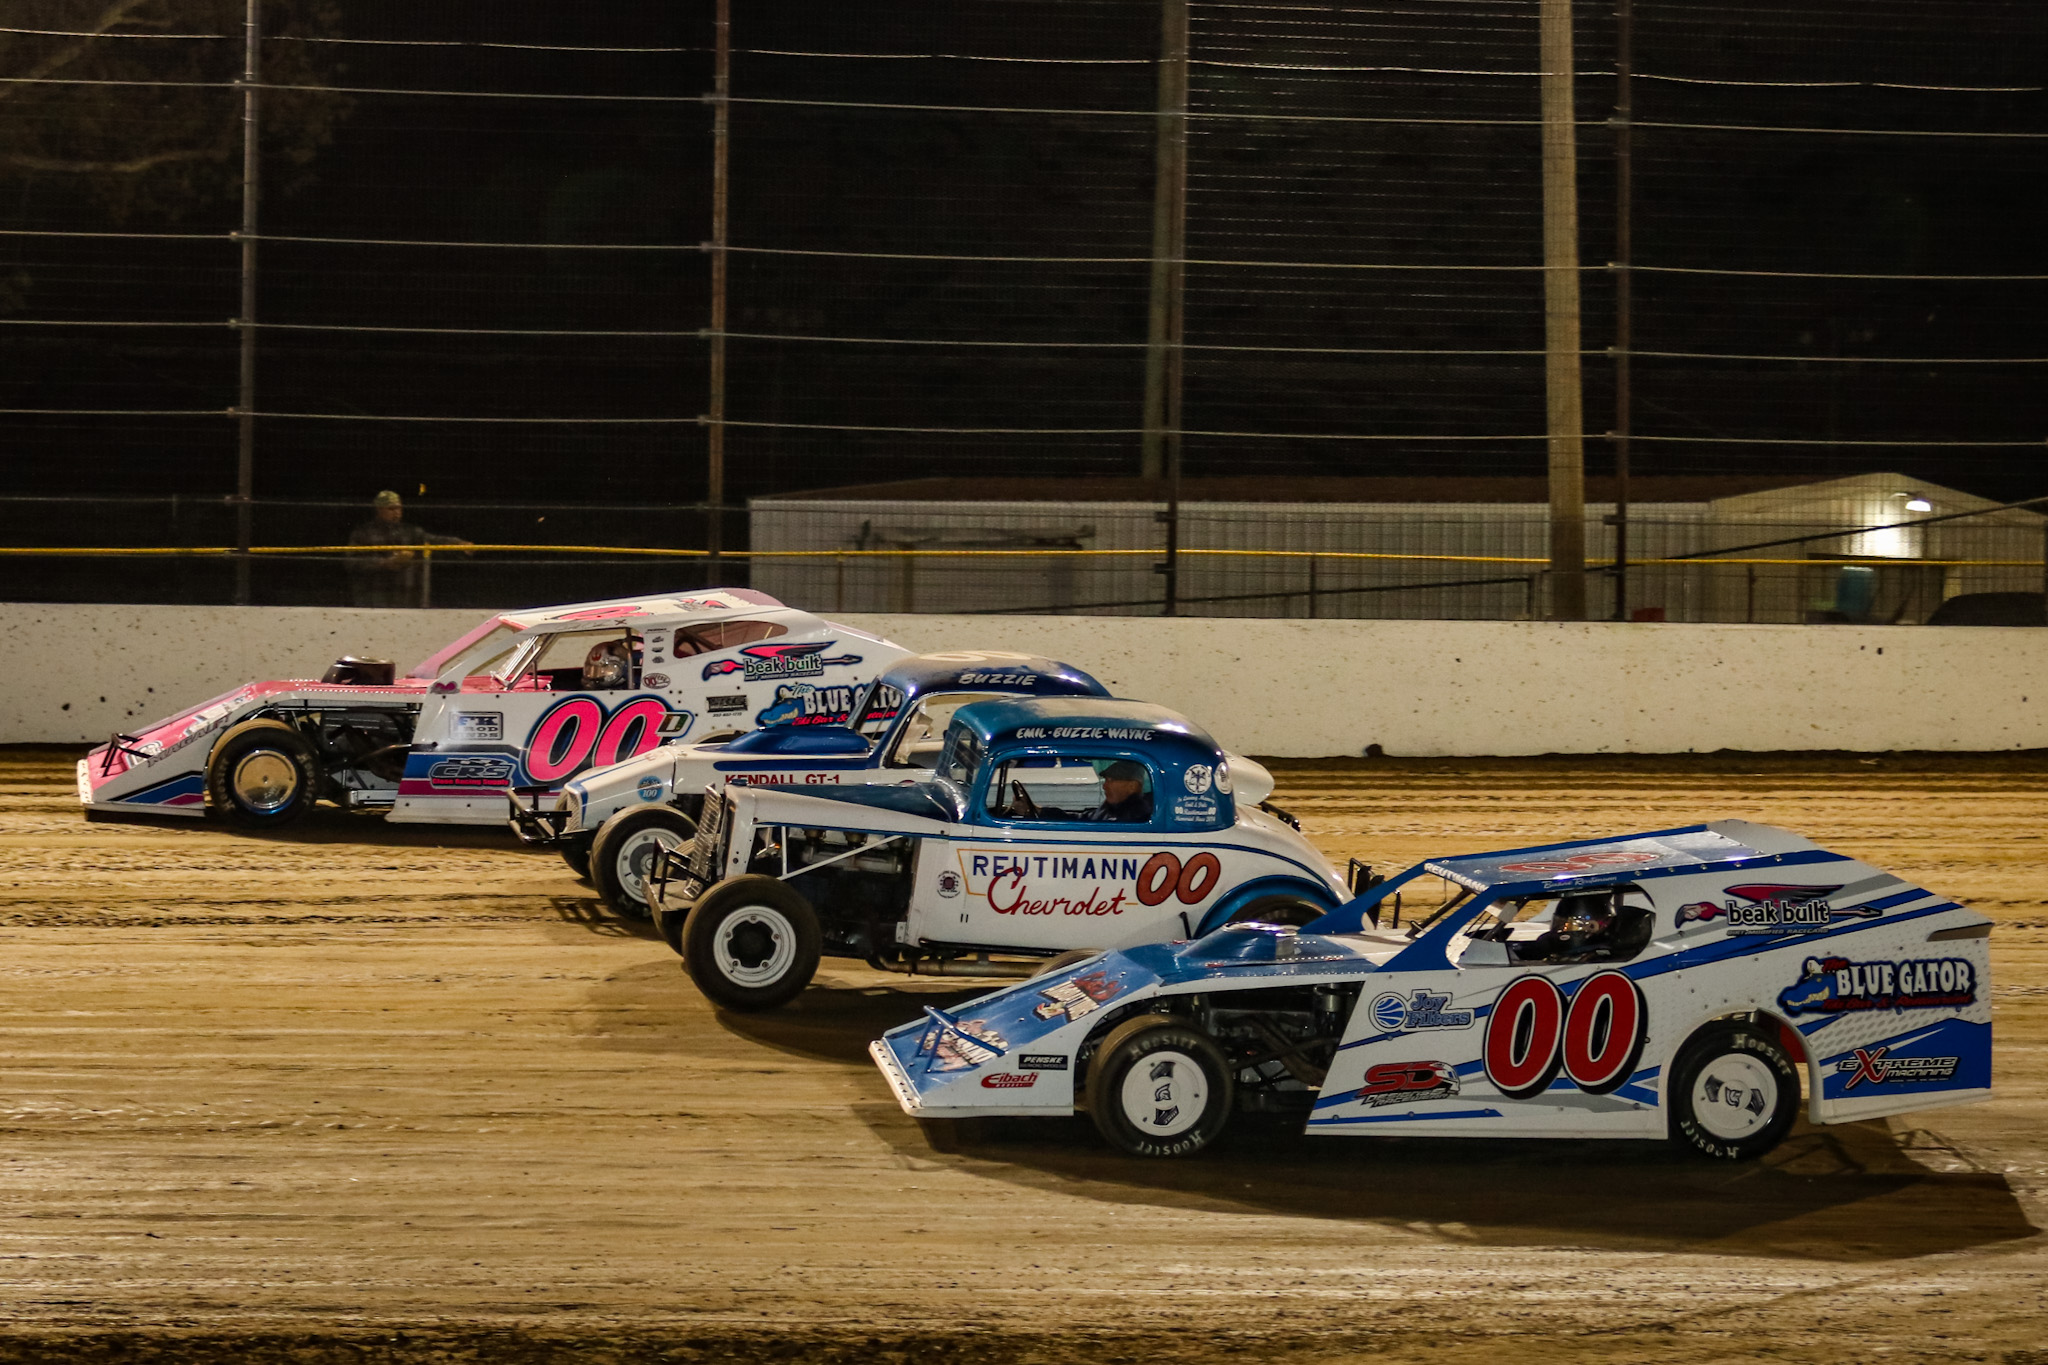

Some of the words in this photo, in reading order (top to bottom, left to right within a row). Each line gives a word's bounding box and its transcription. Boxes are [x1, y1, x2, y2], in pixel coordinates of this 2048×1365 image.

[744, 658, 783, 676] beak
[785, 654, 821, 671] built
[959, 673, 1036, 686] BUZZIE
[804, 687, 850, 715] BLUE
[854, 685, 903, 709] GTO
[525, 697, 668, 782] 00
[431, 764, 511, 779] CRS
[805, 774, 840, 785] GT-1
[643, 789, 658, 798] 100
[973, 855, 1137, 880] REUTIMANN
[1136, 851, 1221, 906] 00
[988, 867, 1126, 915] Chevrolet
[1726, 900, 1779, 926] beak
[1782, 899, 1830, 925] built
[1836, 964, 1895, 999] BLUE
[1900, 960, 1971, 997] GATOR
[1411, 993, 1448, 1010] Joy
[1405, 1011, 1471, 1028] Filters
[1483, 970, 1644, 1095] 00
[1024, 1056, 1063, 1064] PENSKE
[1839, 1047, 1958, 1089] EXTREME
[981, 1072, 1039, 1088] Eibach
[1357, 1061, 1446, 1097] SD
